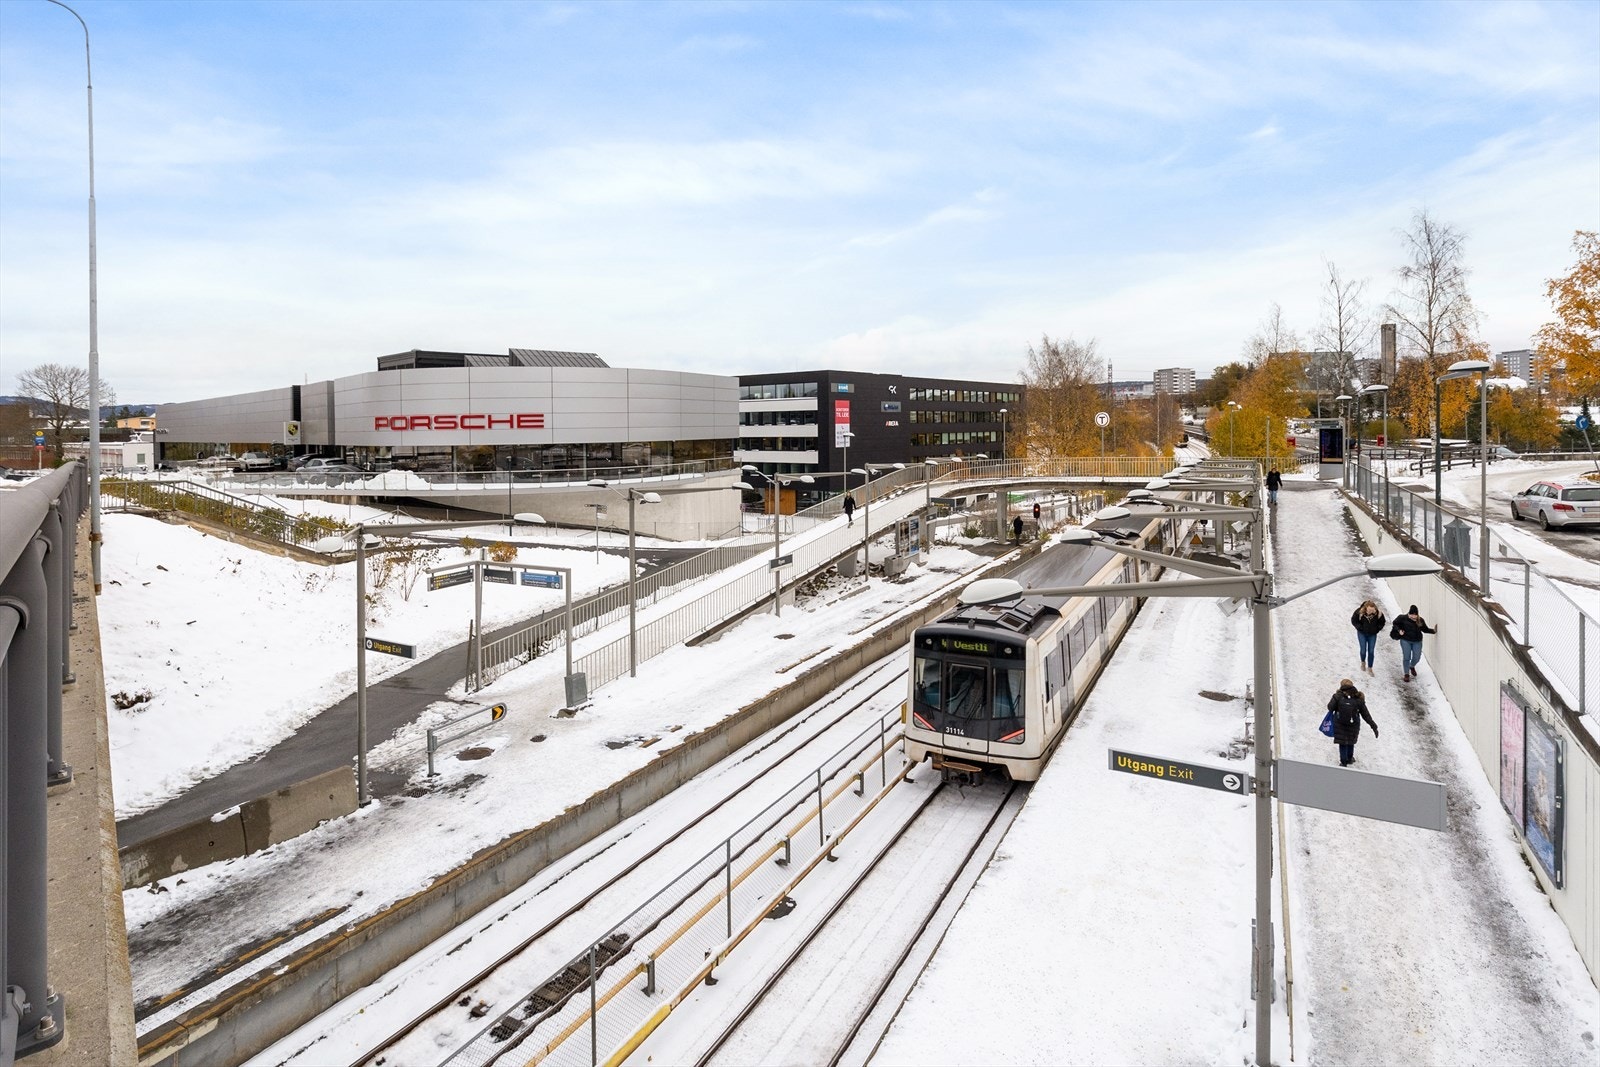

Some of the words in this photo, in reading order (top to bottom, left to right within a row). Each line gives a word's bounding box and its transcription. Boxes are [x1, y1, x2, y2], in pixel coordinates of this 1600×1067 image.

[375, 413, 545, 431] PORSCHE
[1099, 416, 1105, 424] T
[373, 642, 391, 653] Utgang
[392, 645, 402, 653] Exit
[954, 640, 988, 651] Vestli
[945, 726, 965, 736] 31114
[1117, 755, 1164, 777] Utgang
[1169, 765, 1194, 780] Exit
